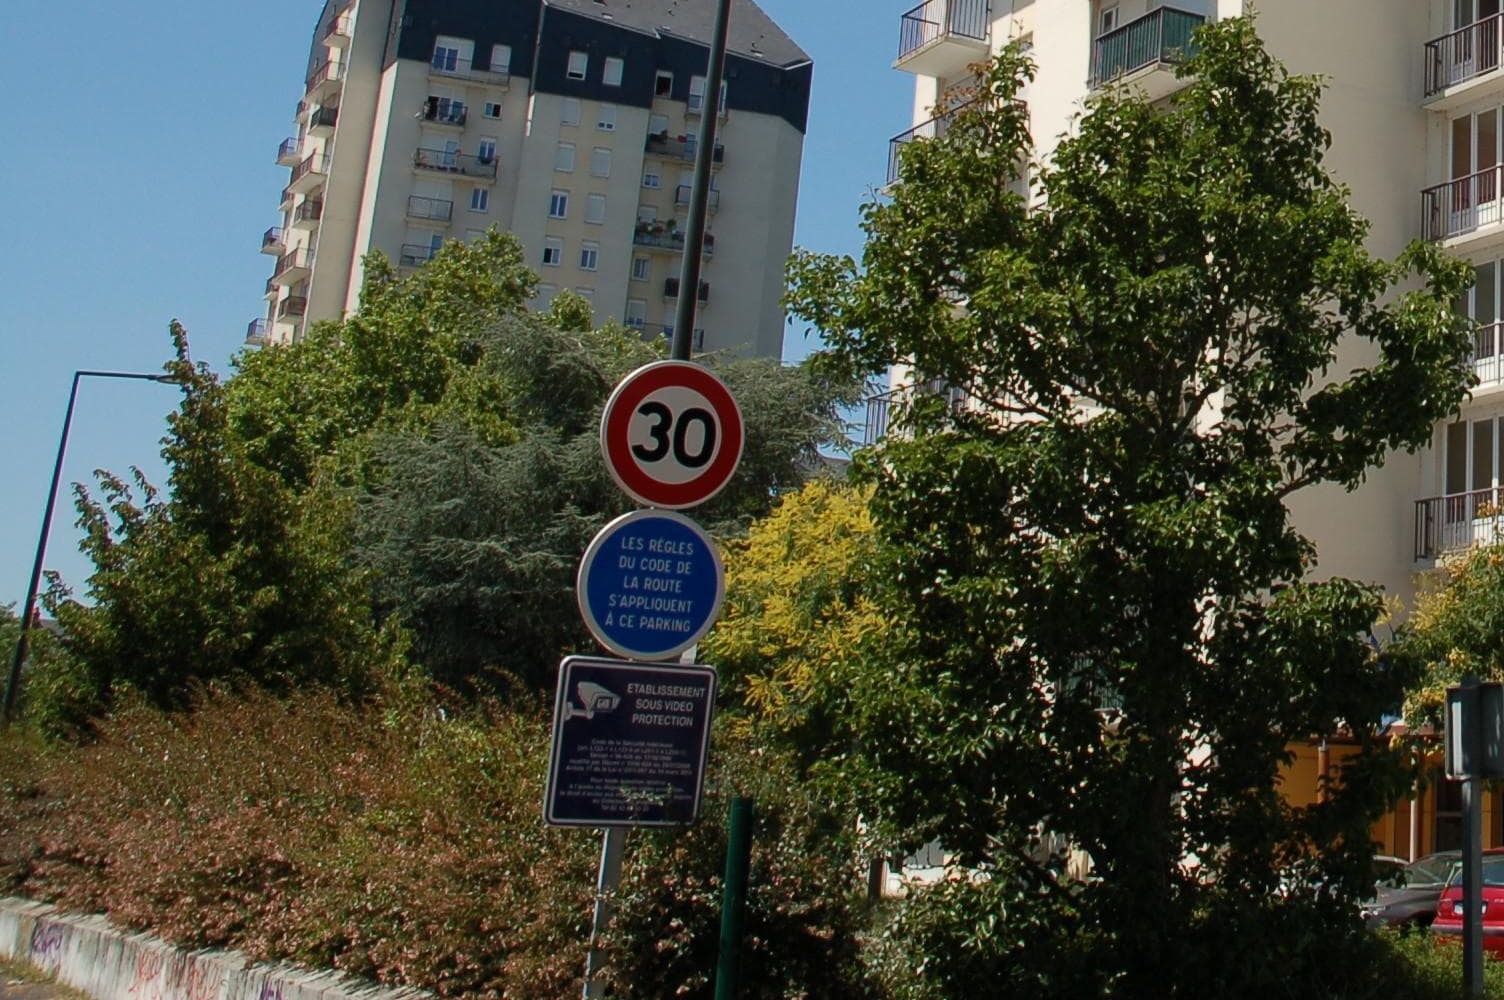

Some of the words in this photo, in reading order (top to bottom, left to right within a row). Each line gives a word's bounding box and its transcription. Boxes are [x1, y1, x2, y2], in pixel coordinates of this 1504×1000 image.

[631, 401, 716, 468] 30
[621, 536, 644, 550] LES
[618, 555, 635, 569] DU
[640, 557, 671, 573] CODE
[676, 561, 692, 575] DE
[623, 575, 638, 589] LA
[643, 577, 682, 593] ROUTE
[608, 593, 693, 613] S'APPLIQUENT
[619, 614, 635, 628] CE
[639, 615, 691, 633] PARKING
[627, 683, 706, 698] ETABLISSEMENT
[635, 699, 662, 711] SOUS
[631, 713, 694, 727] PROTECTION
